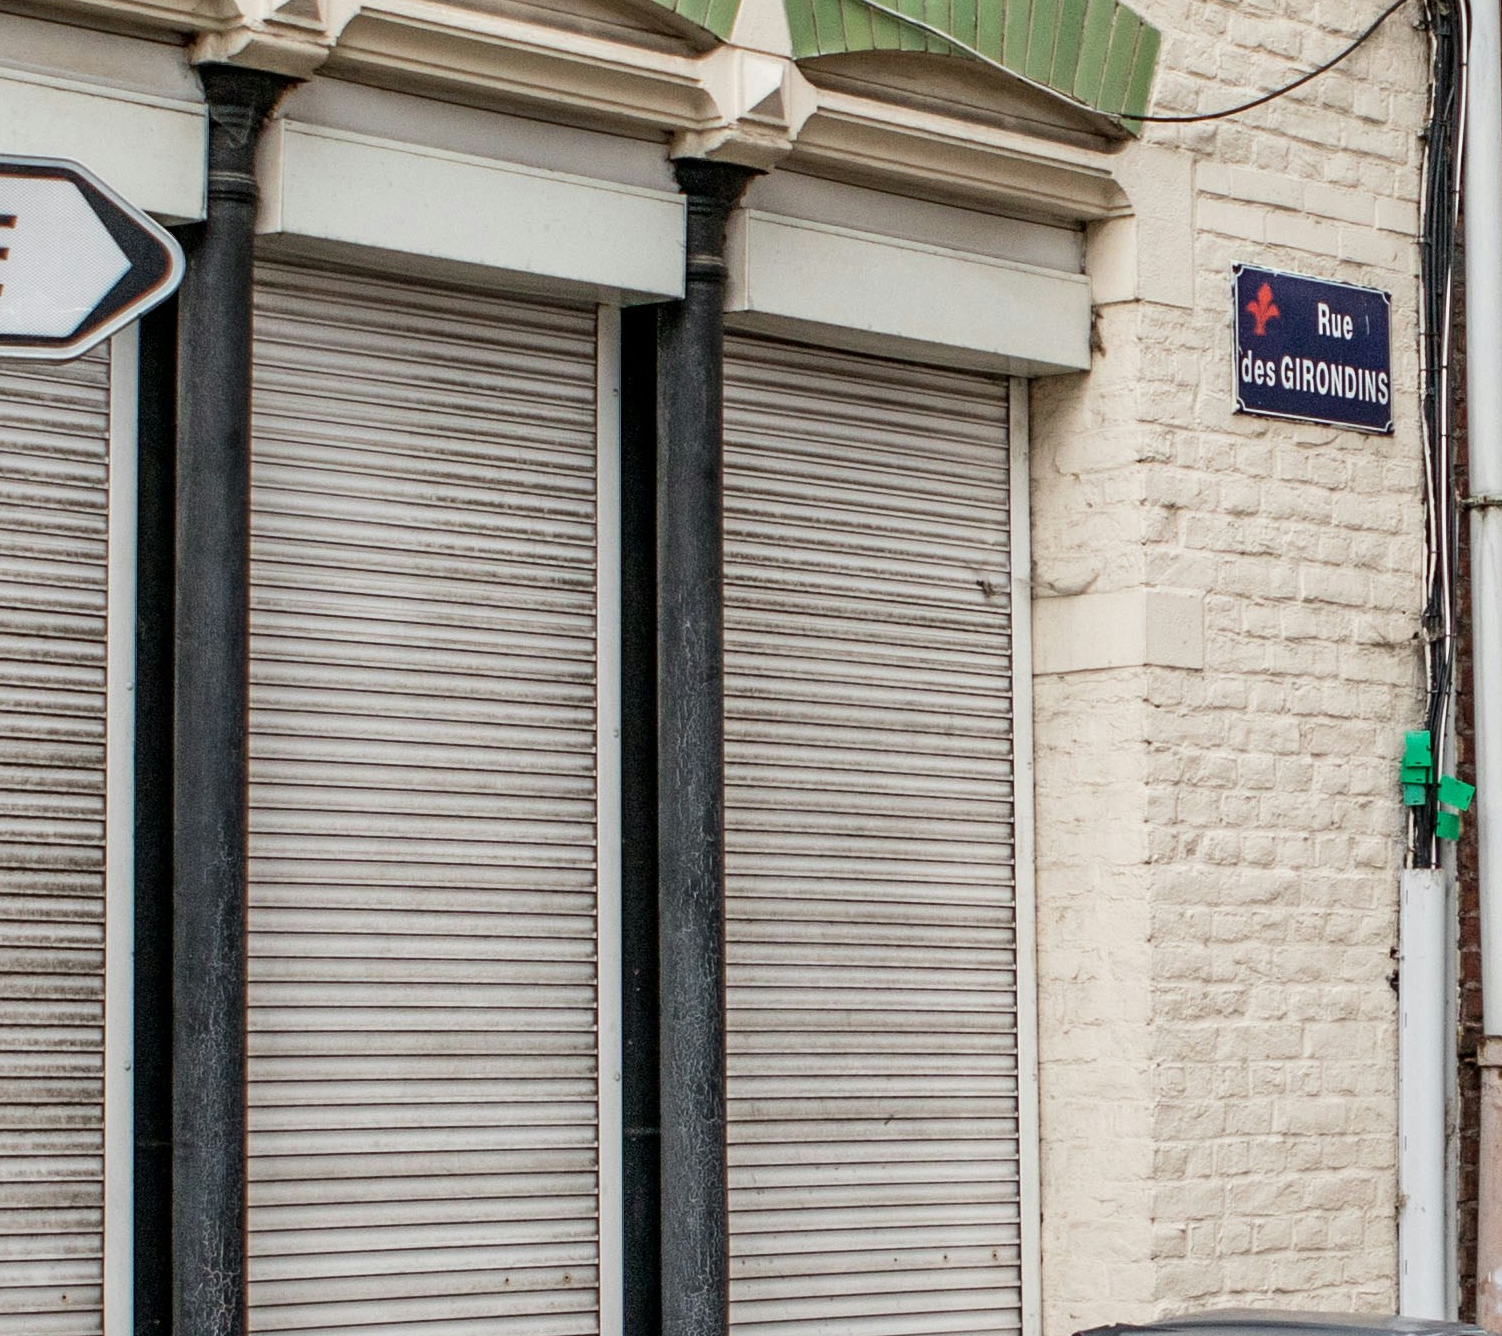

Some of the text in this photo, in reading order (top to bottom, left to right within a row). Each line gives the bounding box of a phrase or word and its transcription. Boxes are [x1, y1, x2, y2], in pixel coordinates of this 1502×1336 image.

[1317, 302, 1354, 340] Rue
[1241, 349, 1389, 405] des GIRONDINS
